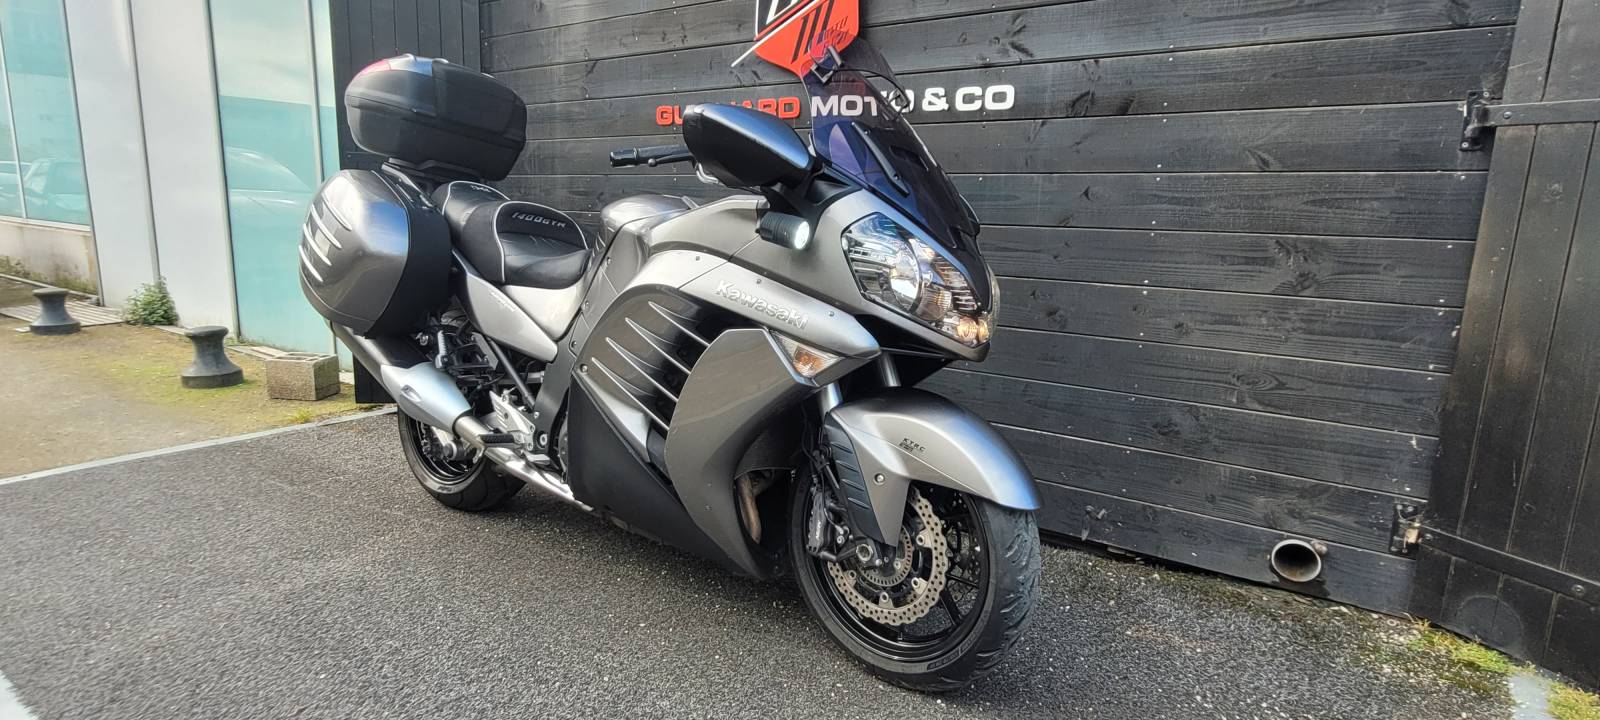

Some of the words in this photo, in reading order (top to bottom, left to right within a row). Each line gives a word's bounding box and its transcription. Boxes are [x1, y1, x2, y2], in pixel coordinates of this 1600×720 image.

[921, 86, 950, 112] &
[955, 84, 1015, 112] CO
[715, 279, 809, 331] Kawasaki
